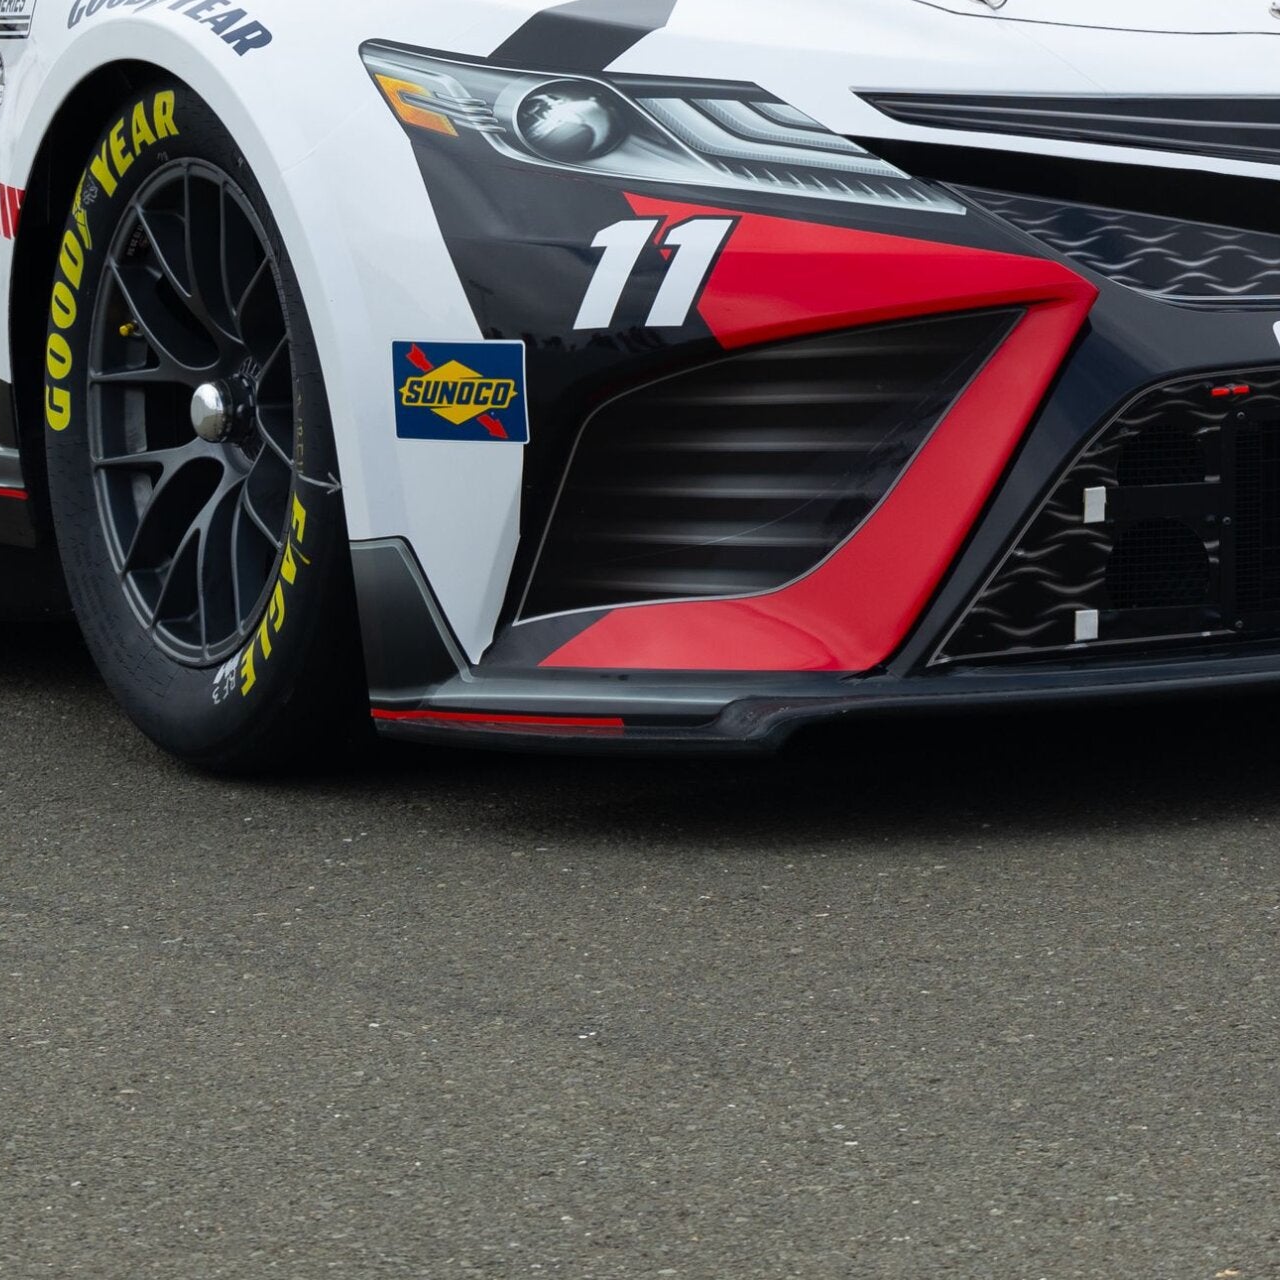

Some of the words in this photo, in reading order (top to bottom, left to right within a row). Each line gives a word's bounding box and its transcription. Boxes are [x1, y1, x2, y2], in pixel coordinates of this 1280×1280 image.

[44, 89, 180, 432] GOODYEAR
[572, 218, 735, 330] 11
[404, 379, 513, 408] SUNOCO
[240, 489, 308, 697] EAGLE
